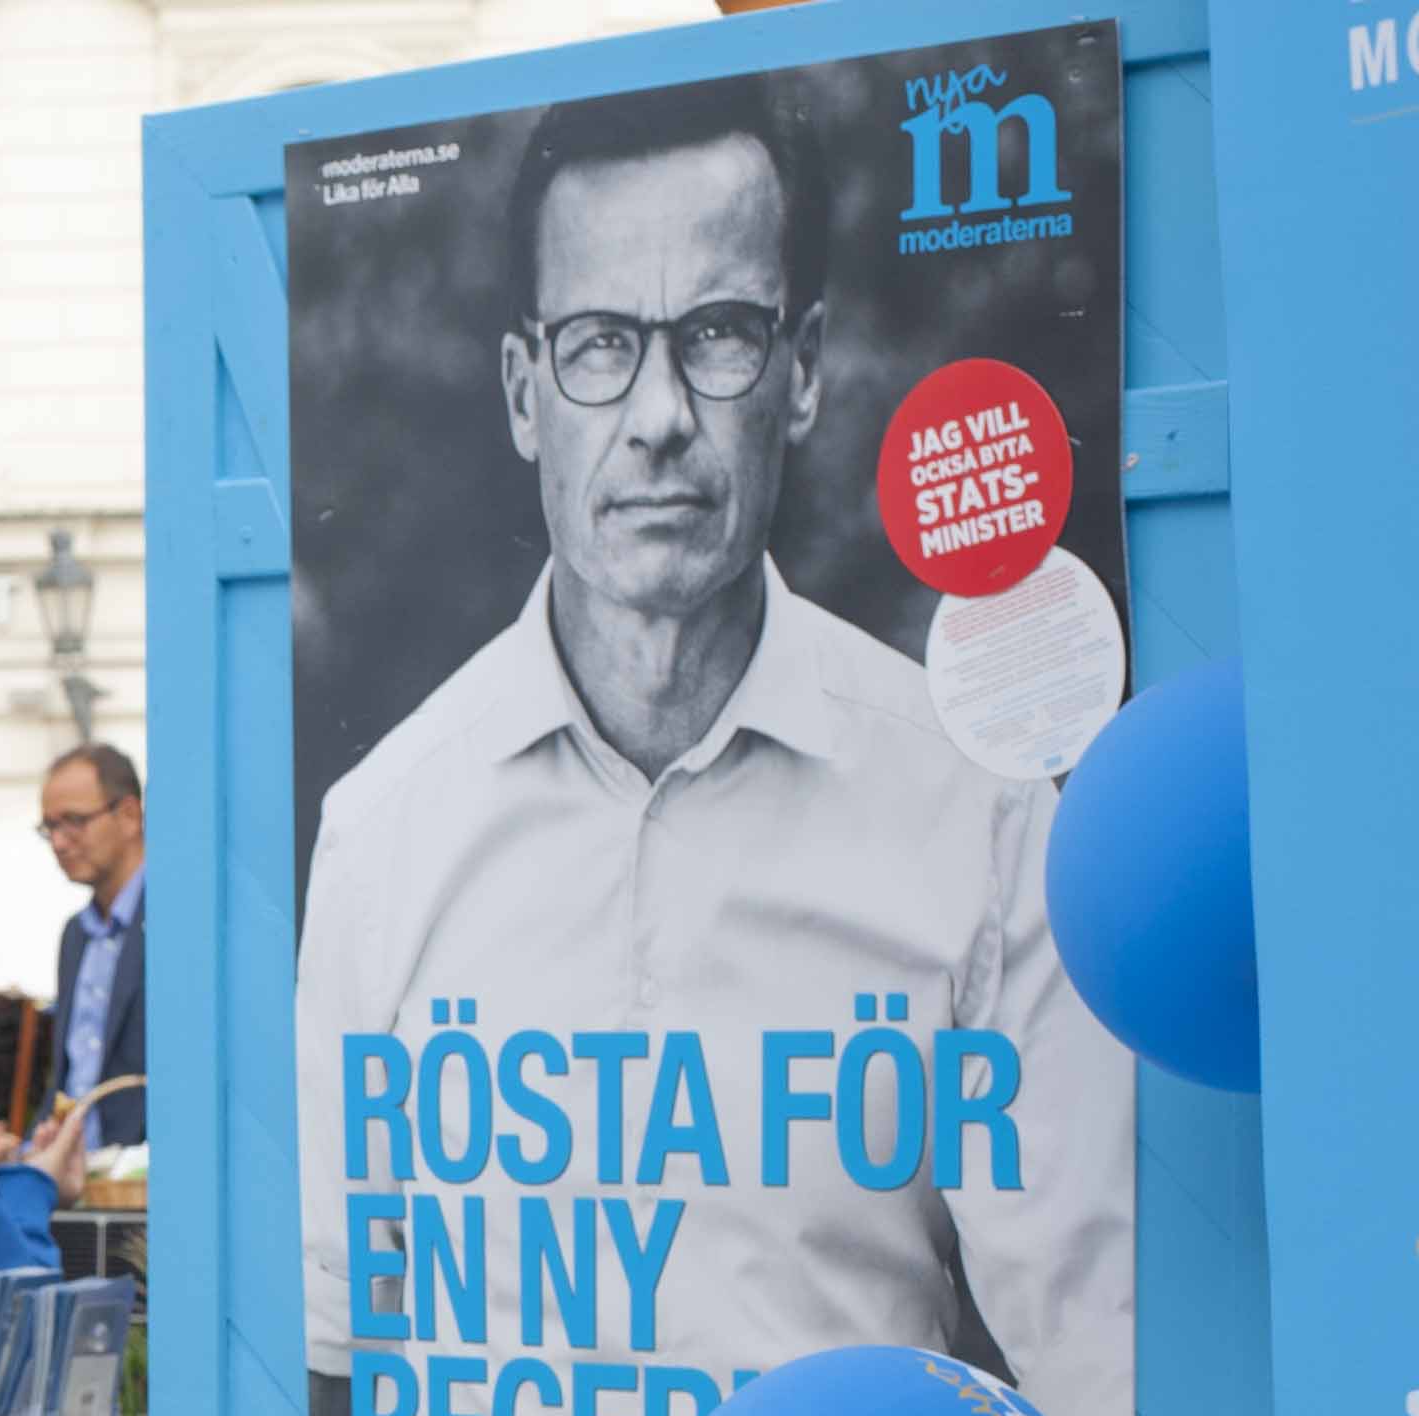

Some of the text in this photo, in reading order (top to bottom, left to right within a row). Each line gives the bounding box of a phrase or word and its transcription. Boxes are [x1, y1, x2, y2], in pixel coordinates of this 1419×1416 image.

[1349, 10, 1419, 91] M
[905, 64, 1007, 133] nya
[322, 142, 459, 178] moderaterna.se
[900, 93, 1072, 221] m
[898, 213, 1073, 255] moderaterna
[908, 401, 1030, 461] JAG VILL
[978, 433, 1034, 467] BYTA
[915, 463, 1040, 526] STATS-
[920, 499, 1046, 559] MINISTER
[342, 993, 1025, 1191] RÖSTA FÖR
[347, 1193, 686, 1351] EN NY
